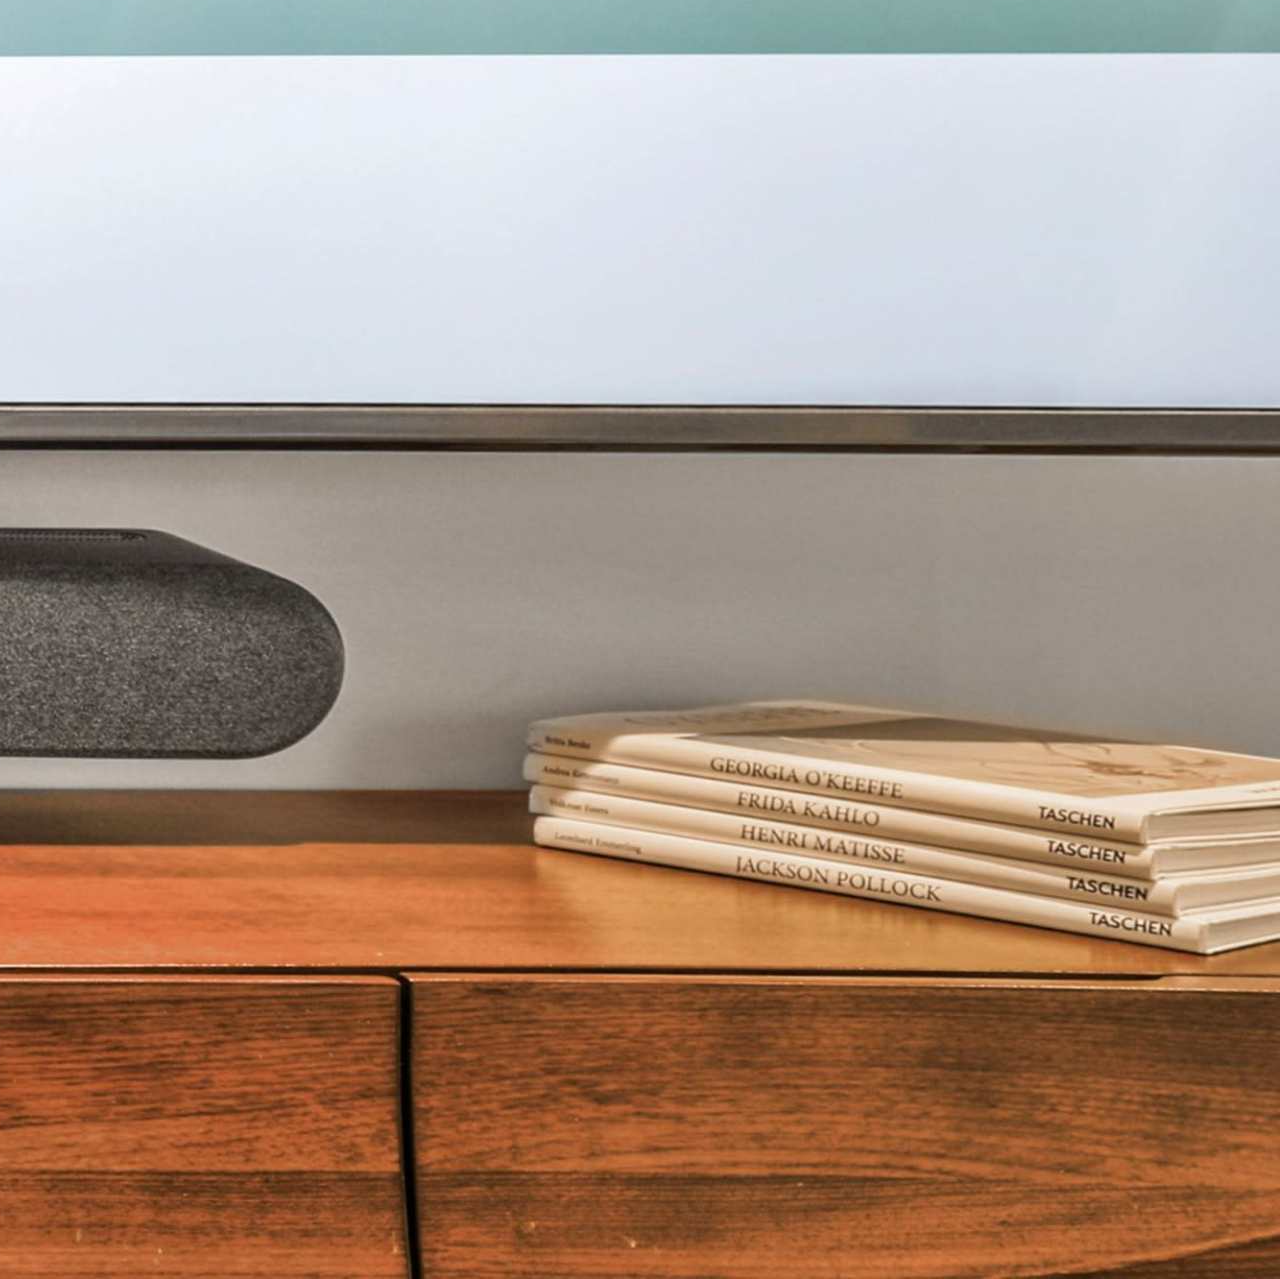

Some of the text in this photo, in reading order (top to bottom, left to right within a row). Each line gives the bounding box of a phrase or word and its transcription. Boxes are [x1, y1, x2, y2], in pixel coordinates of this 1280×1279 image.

[710, 757, 904, 799] GEORGIA O'KEEFFE
[737, 791, 881, 827] FRIDA KAHLO
[1038, 806, 1116, 830] TASCHEN
[741, 824, 906, 864] HENRI MATISSE
[1048, 840, 1127, 865] TASCHEN
[736, 856, 942, 902] JACKSON POLLOCK
[1067, 876, 1149, 901] TASCHEN
[1090, 912, 1173, 938] TASCHEN
